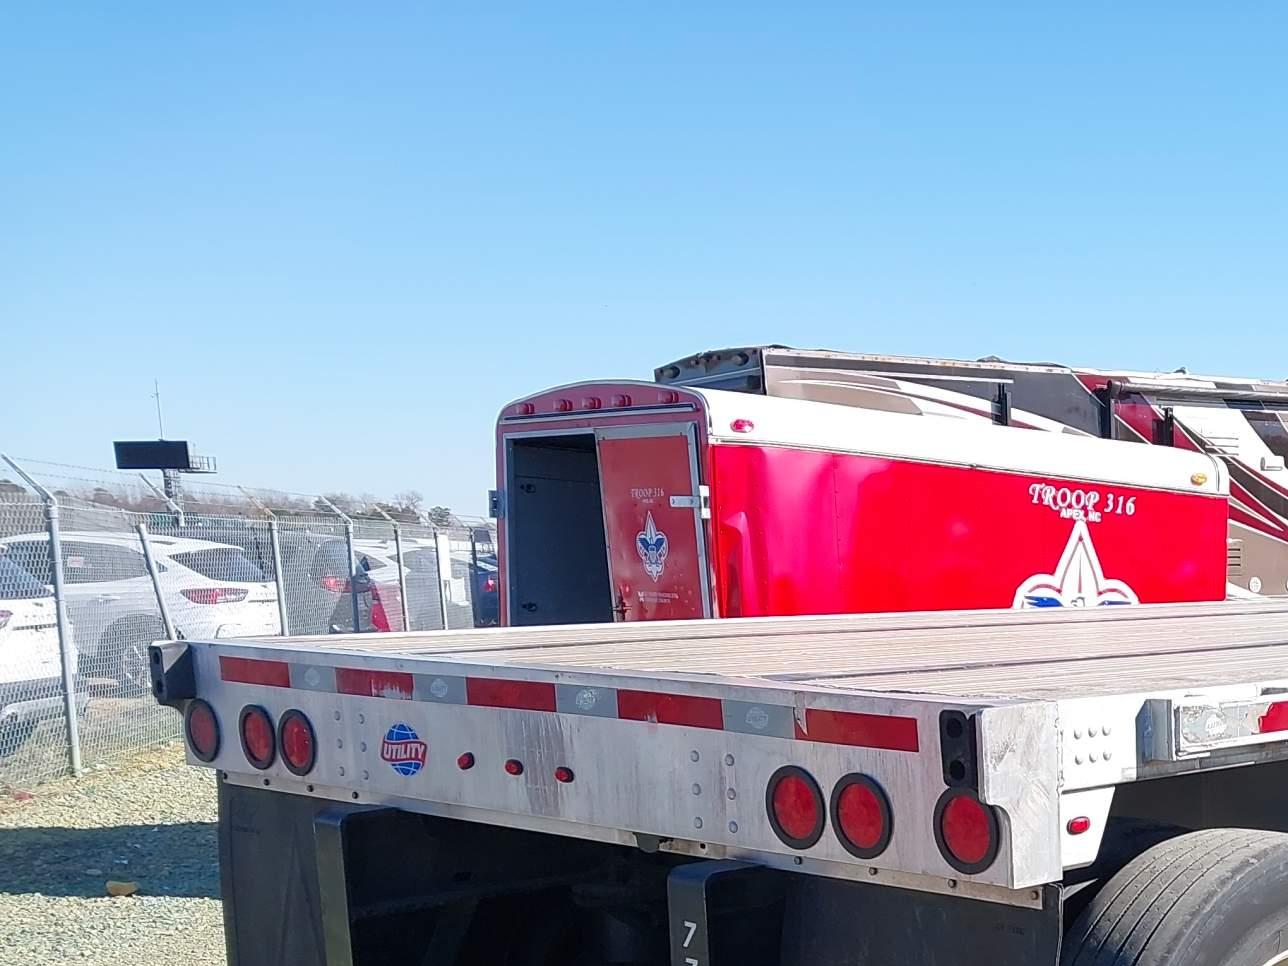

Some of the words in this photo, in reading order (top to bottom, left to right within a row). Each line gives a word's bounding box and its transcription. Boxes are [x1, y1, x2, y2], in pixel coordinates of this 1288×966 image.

[1028, 483, 1100, 511] TROOP
[1103, 493, 1137, 516] 316
[1087, 511, 1102, 523] NC
[383, 742, 425, 760] UTILITY
